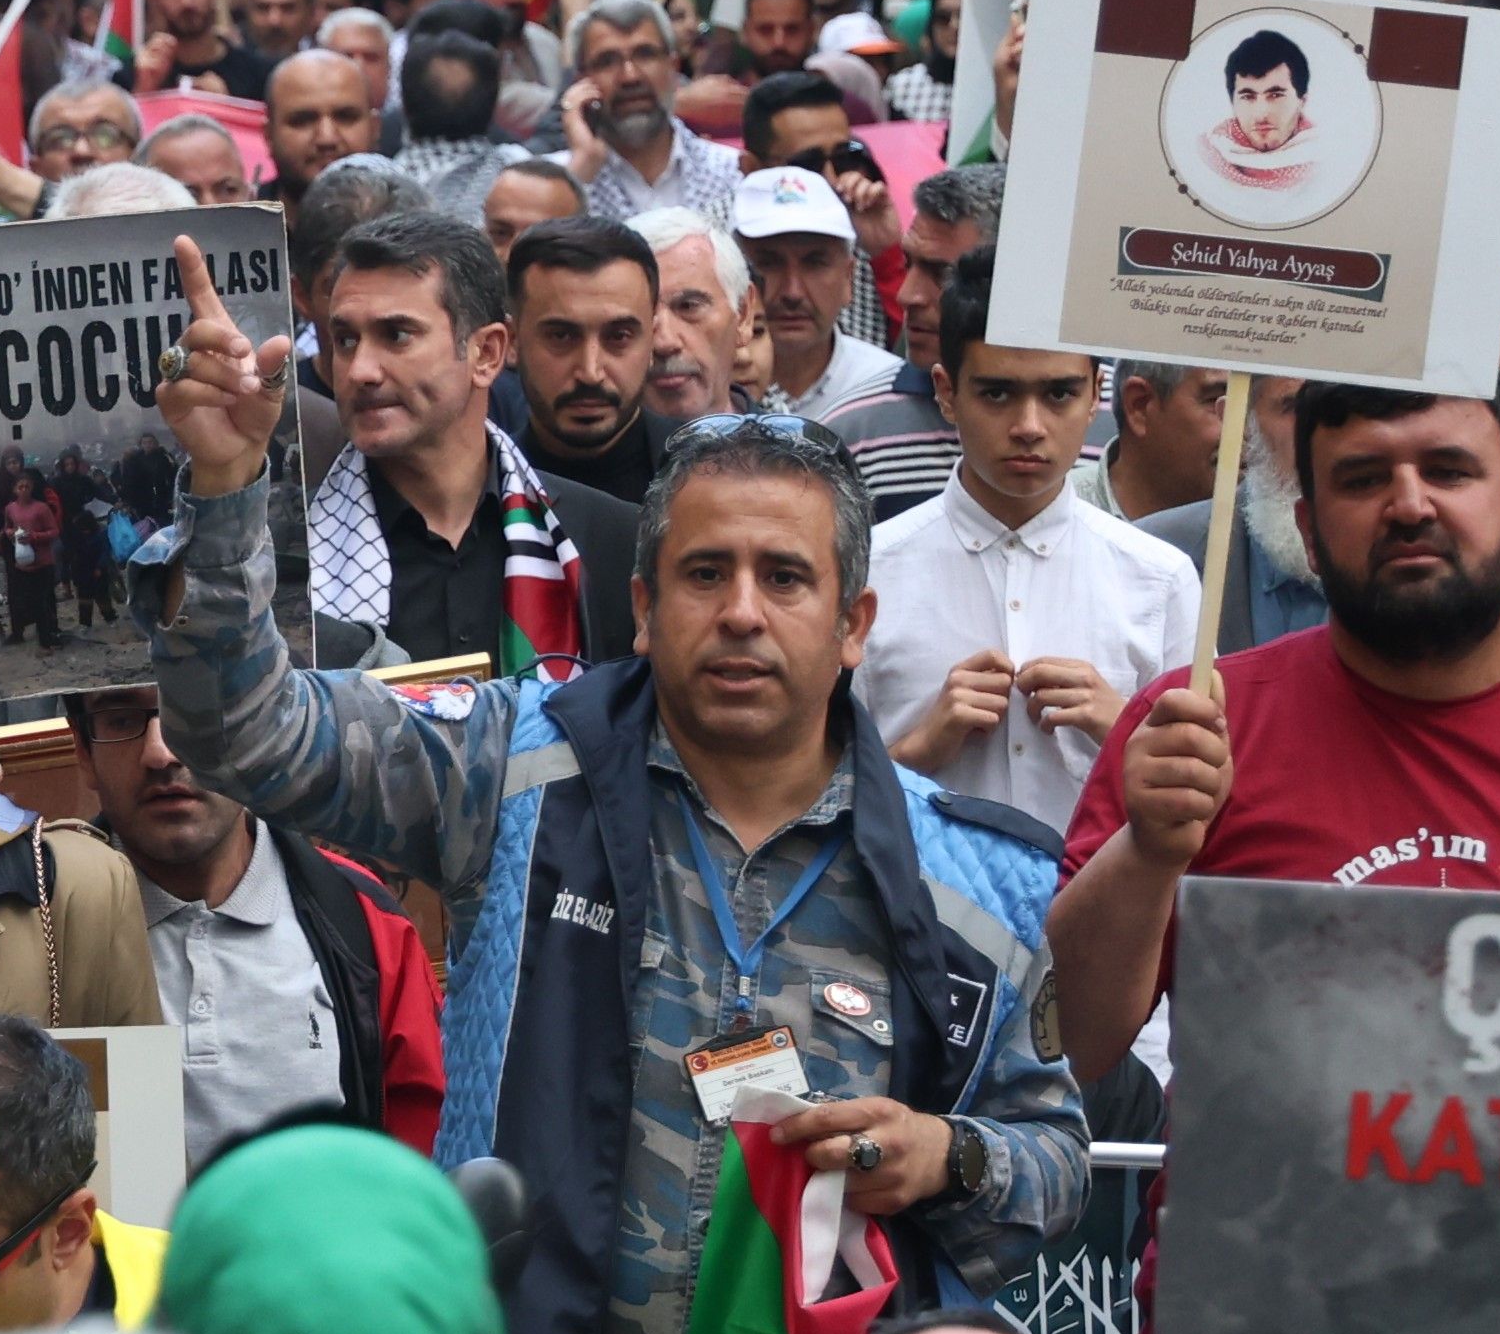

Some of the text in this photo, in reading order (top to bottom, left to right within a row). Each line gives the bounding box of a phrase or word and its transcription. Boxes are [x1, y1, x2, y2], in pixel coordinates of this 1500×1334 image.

[1171, 241, 1335, 282] Şehid Yahya Ayyaş
[31, 259, 135, 314] İNDEN
[142, 247, 281, 303] FALASI
[1148, 284, 1194, 300] yolunda
[1272, 296, 1304, 313] sakın
[1307, 297, 1326, 312] ölü
[1327, 303, 1388, 318] zannetme!
[1173, 303, 1204, 317] onlar
[1259, 313, 1273, 324] ve
[550, 887, 574, 921] ZİZ
